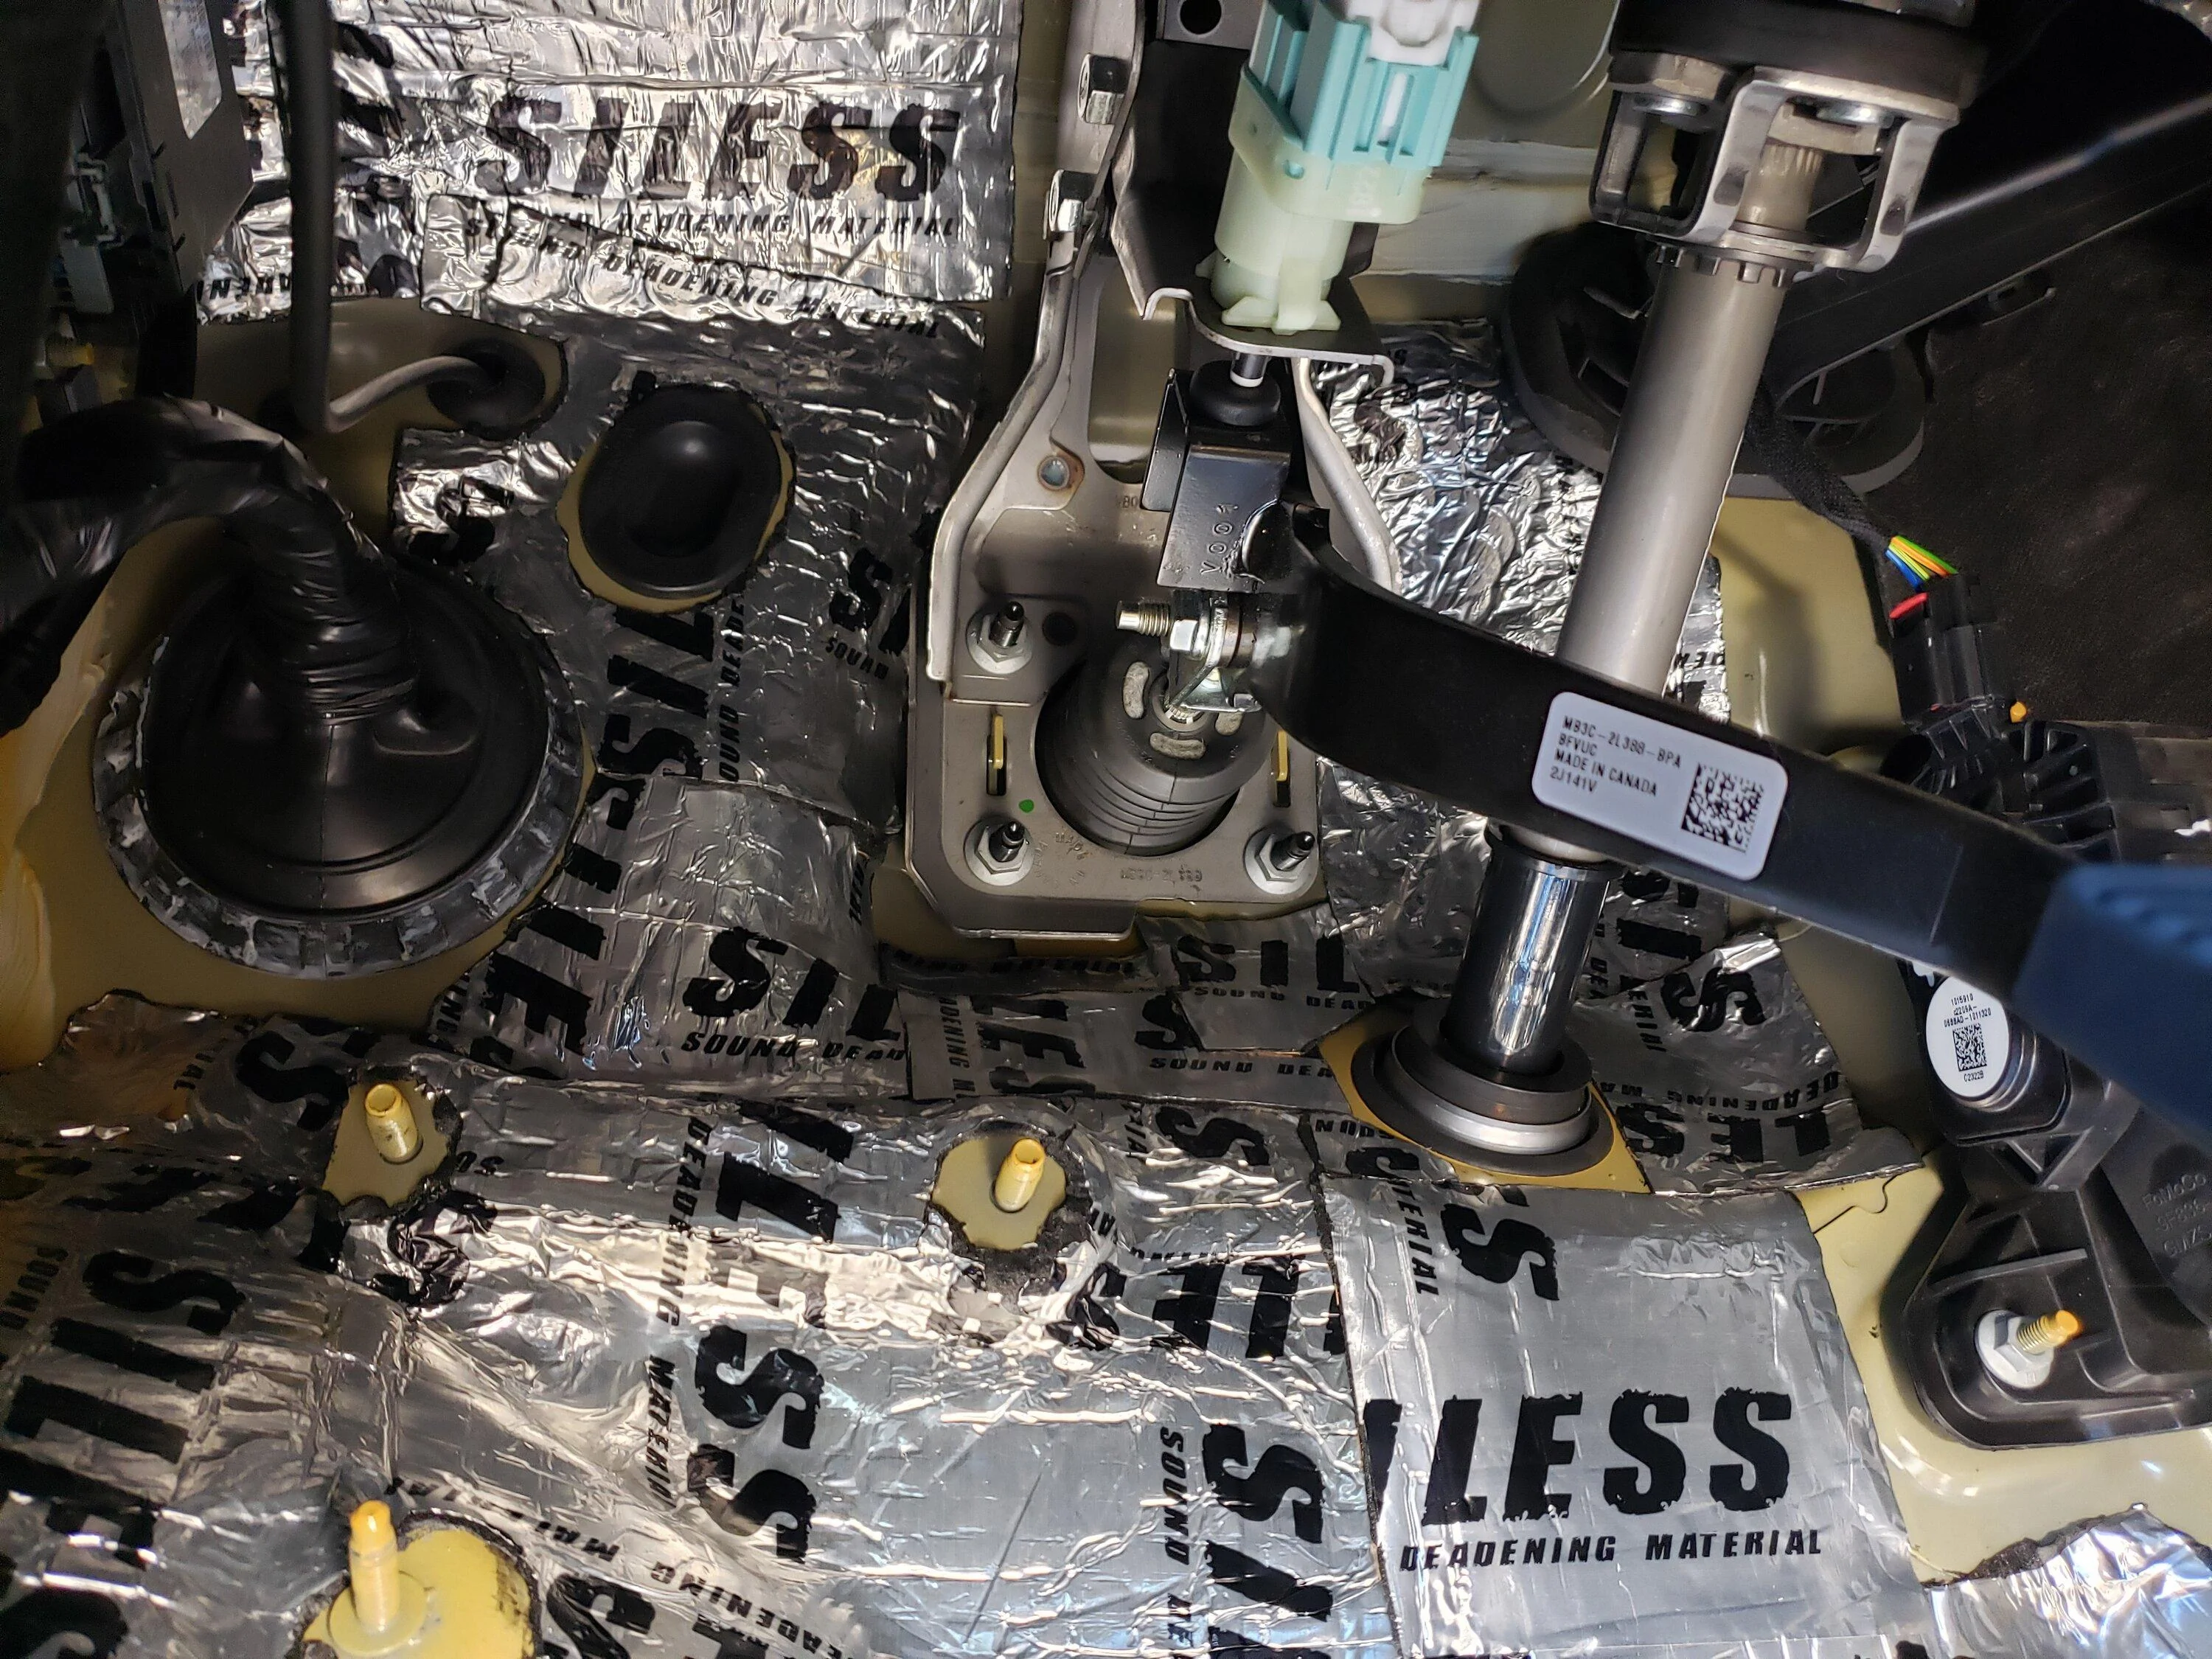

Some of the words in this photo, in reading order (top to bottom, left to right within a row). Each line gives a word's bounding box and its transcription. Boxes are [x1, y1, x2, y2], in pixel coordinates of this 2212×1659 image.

[1558, 733, 1598, 757] BFVUC
[1554, 748, 1587, 771] MADE
[1591, 761, 1606, 777] IN
[1608, 768, 1658, 797] CANADA
[682, 925, 901, 1043] SIL
[1194, 987, 1286, 1001] SOUND
[681, 1032, 799, 1059] SOUND
[1149, 1057, 1253, 1074] SOUND
[1667, 1071, 1840, 1111] DEADENING
[1160, 1426, 1190, 1565] SOUND
[1400, 1536, 1615, 1572] DEADENING
[1645, 1528, 1822, 1562] MATERIAL
